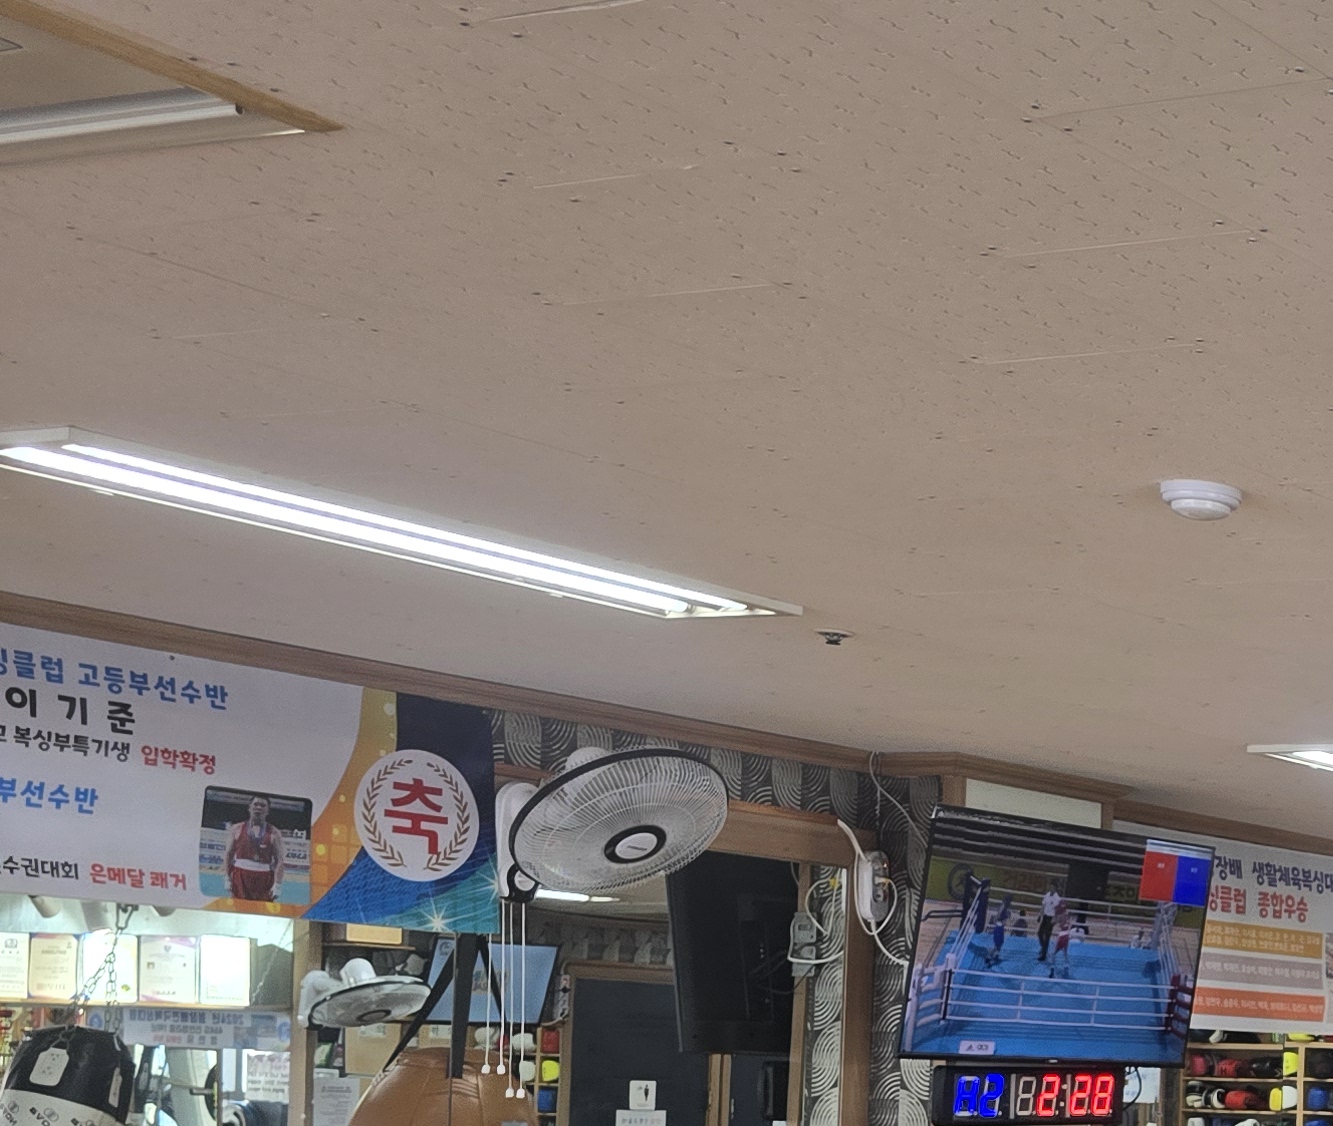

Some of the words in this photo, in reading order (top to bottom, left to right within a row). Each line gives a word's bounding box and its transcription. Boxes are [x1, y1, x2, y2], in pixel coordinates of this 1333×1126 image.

[78, 662, 229, 711] 고등부선수반
[13, 725, 131, 763] 복싱부특기생
[140, 744, 216, 775] 입학확정
[383, 777, 449, 857] 축
[0, 854, 79, 880] 수권대회
[89, 862, 145, 889] 은메달
[1212, 855, 1243, 880] 장배
[1257, 890, 1309, 923] 종합우승
